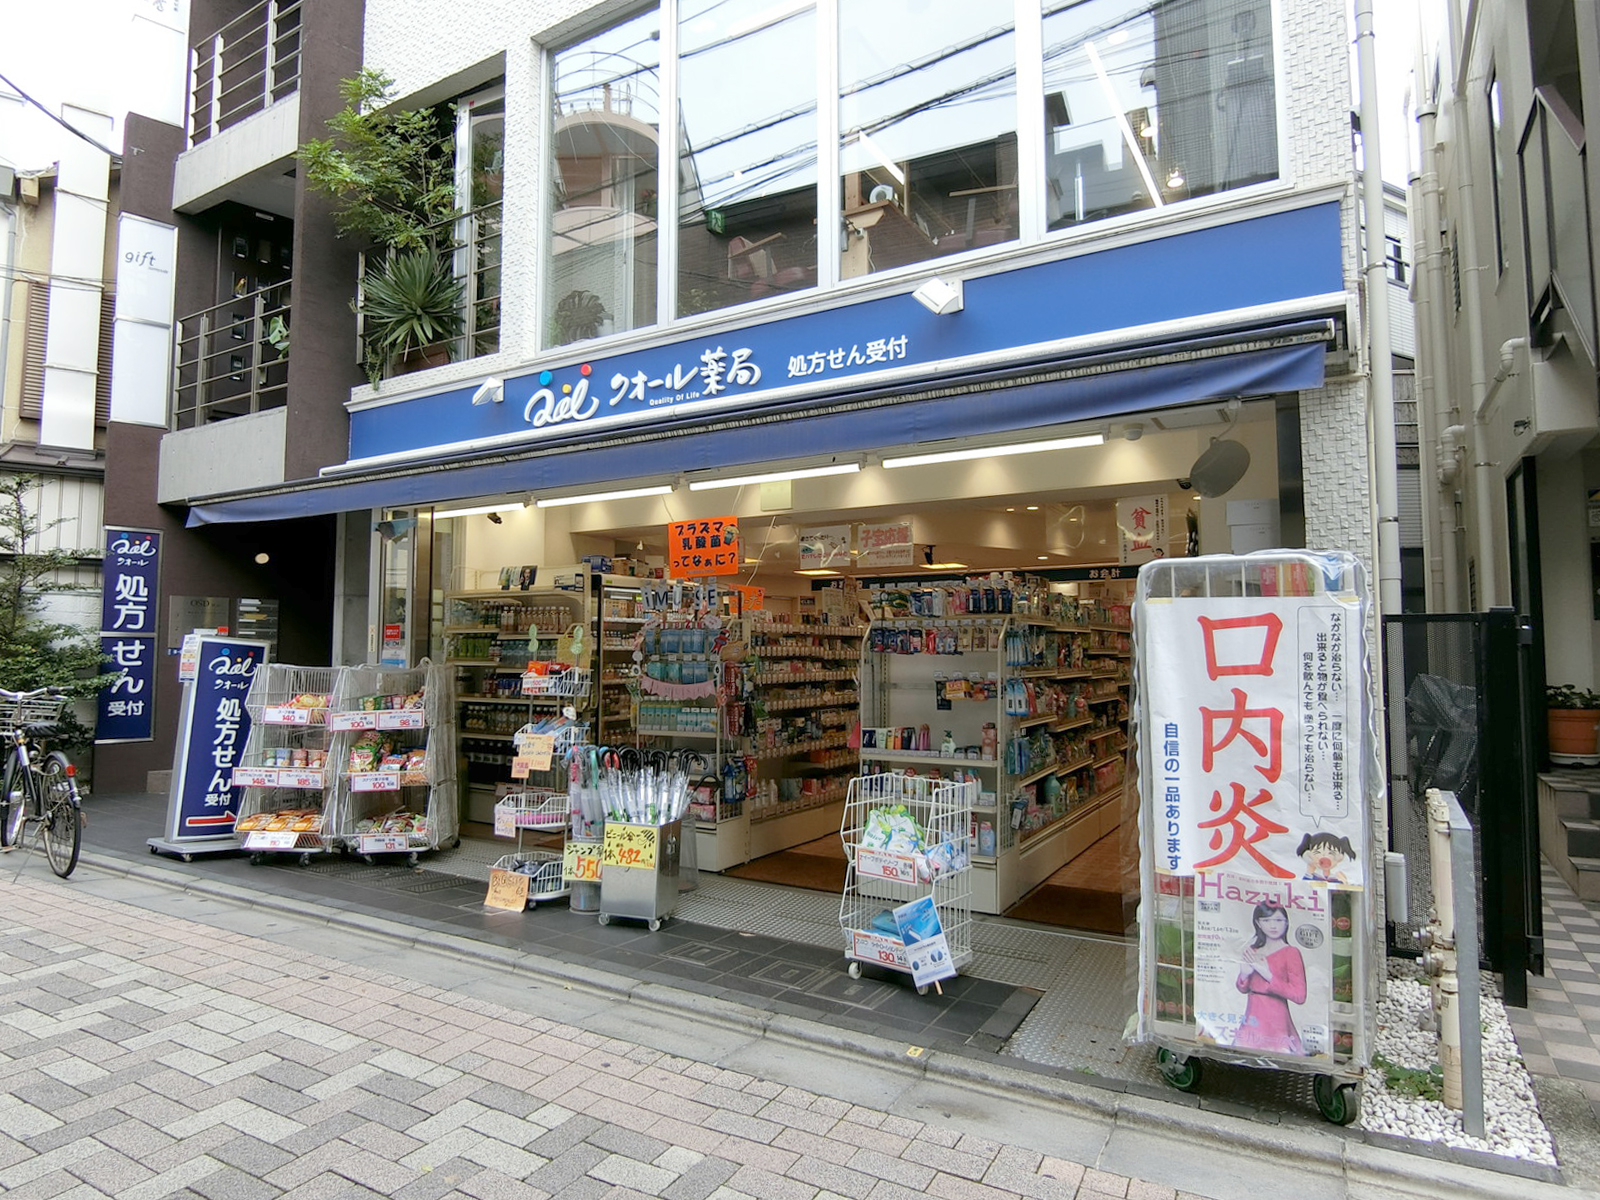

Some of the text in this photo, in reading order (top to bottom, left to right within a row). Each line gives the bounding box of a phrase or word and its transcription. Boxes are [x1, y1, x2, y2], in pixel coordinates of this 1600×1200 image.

[125, 251, 156, 267] gift
[787, 335, 908, 378] 処方せん受付
[609, 346, 762, 406] クオール薬局
[649, 391, 700, 406] Quality Of Life
[682, 535, 721, 550] 乳酸菌
[117, 557, 149, 567] クオール
[214, 679, 249, 690] クオール
[108, 700, 144, 717] 受付
[350, 720, 365, 728] 100
[208, 697, 241, 792] 処方せん
[1193, 612, 1296, 879] 口内炎
[372, 781, 385, 789] 100
[204, 793, 232, 807] 受付
[1163, 722, 1181, 870] 自信の一品あります
[618, 847, 641, 865] 482
[882, 865, 898, 877] 150
[1198, 872, 1324, 912] Hazuki
[878, 950, 895, 963] 130
[1197, 1010, 1258, 1027] 大きく見える
